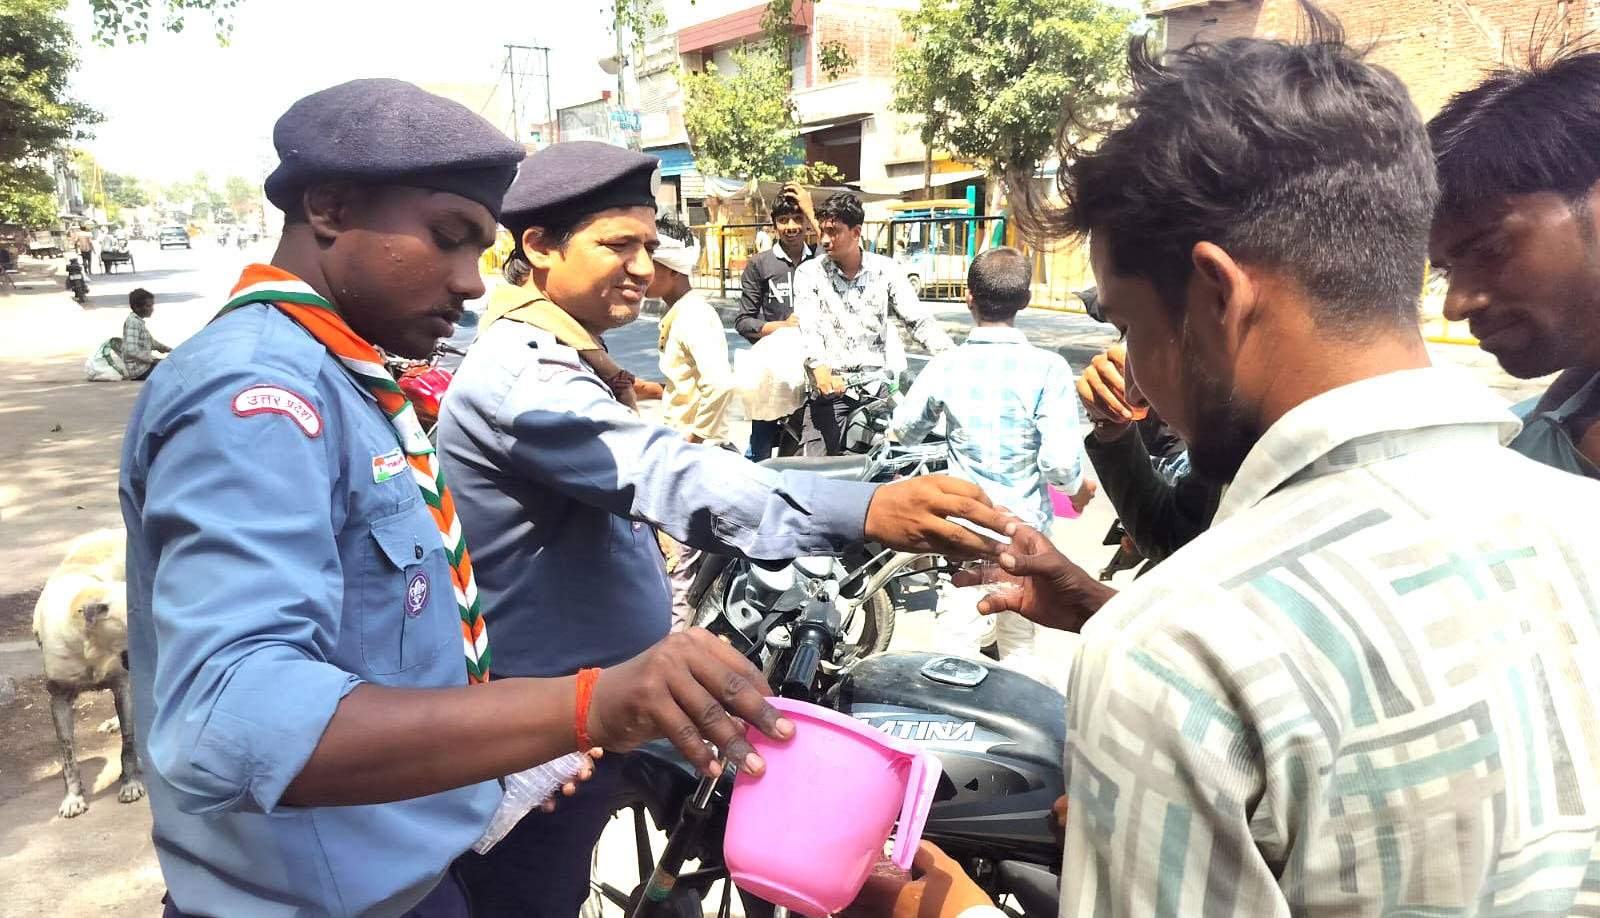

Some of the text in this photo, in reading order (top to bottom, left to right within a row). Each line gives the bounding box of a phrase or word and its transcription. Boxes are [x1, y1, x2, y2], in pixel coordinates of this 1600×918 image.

[246, 394, 314, 421] उत्तर प्रदेश
[859, 718, 977, 741] ATINA
